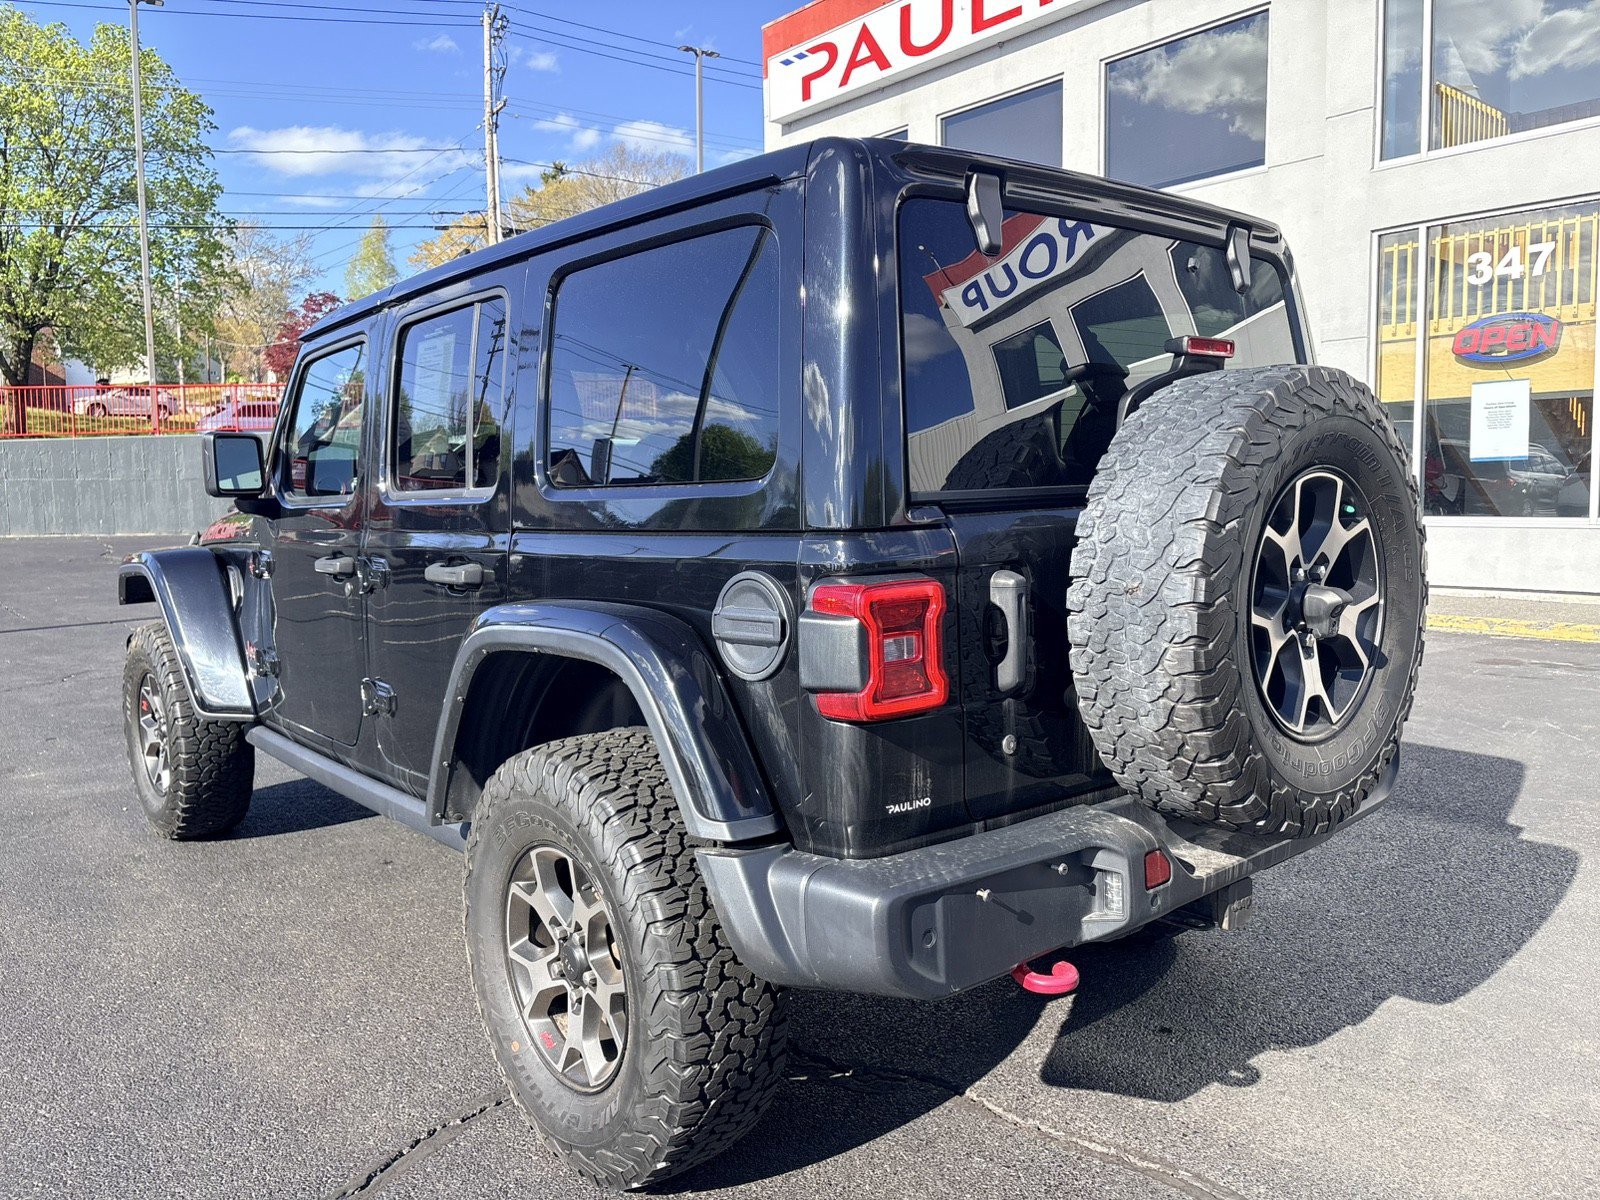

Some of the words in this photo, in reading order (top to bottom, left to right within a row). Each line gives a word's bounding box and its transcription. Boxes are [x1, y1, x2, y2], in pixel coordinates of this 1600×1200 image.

[801, 0, 1051, 101] PAUL
[1467, 241, 1556, 286] 347
[1453, 320, 1560, 355] OPEN
[886, 797, 931, 814] PAULINO
